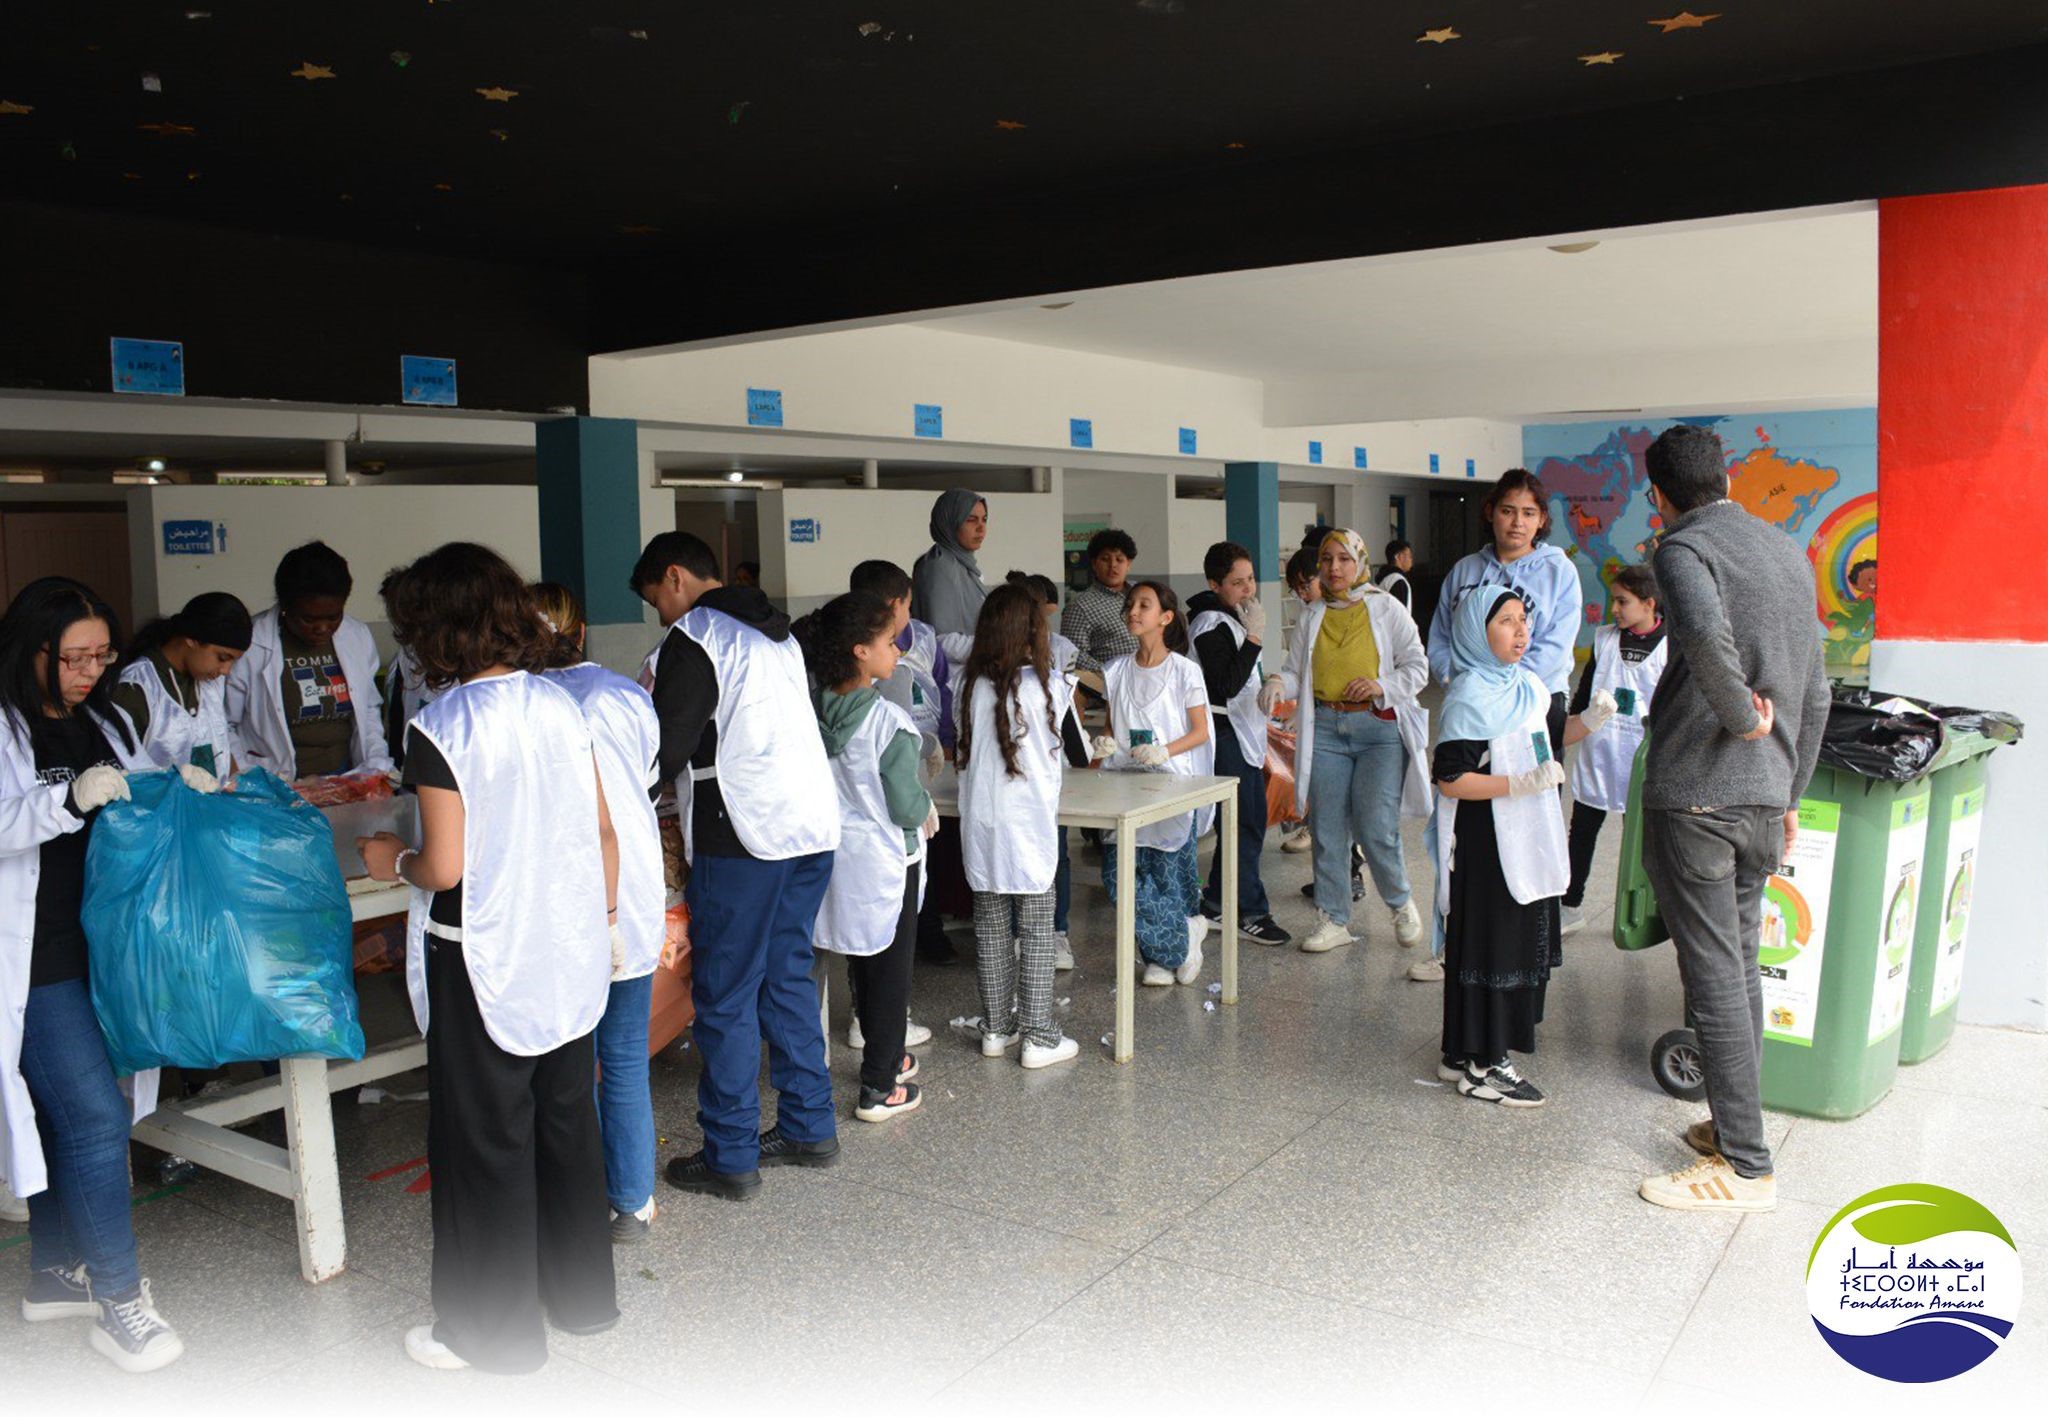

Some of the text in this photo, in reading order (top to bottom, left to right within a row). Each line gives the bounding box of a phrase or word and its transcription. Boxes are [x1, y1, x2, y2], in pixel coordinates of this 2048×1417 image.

[1768, 483, 1787, 499] ASIE
[168, 542, 211, 551] TOILETTES
[285, 654, 335, 668] TOMM
